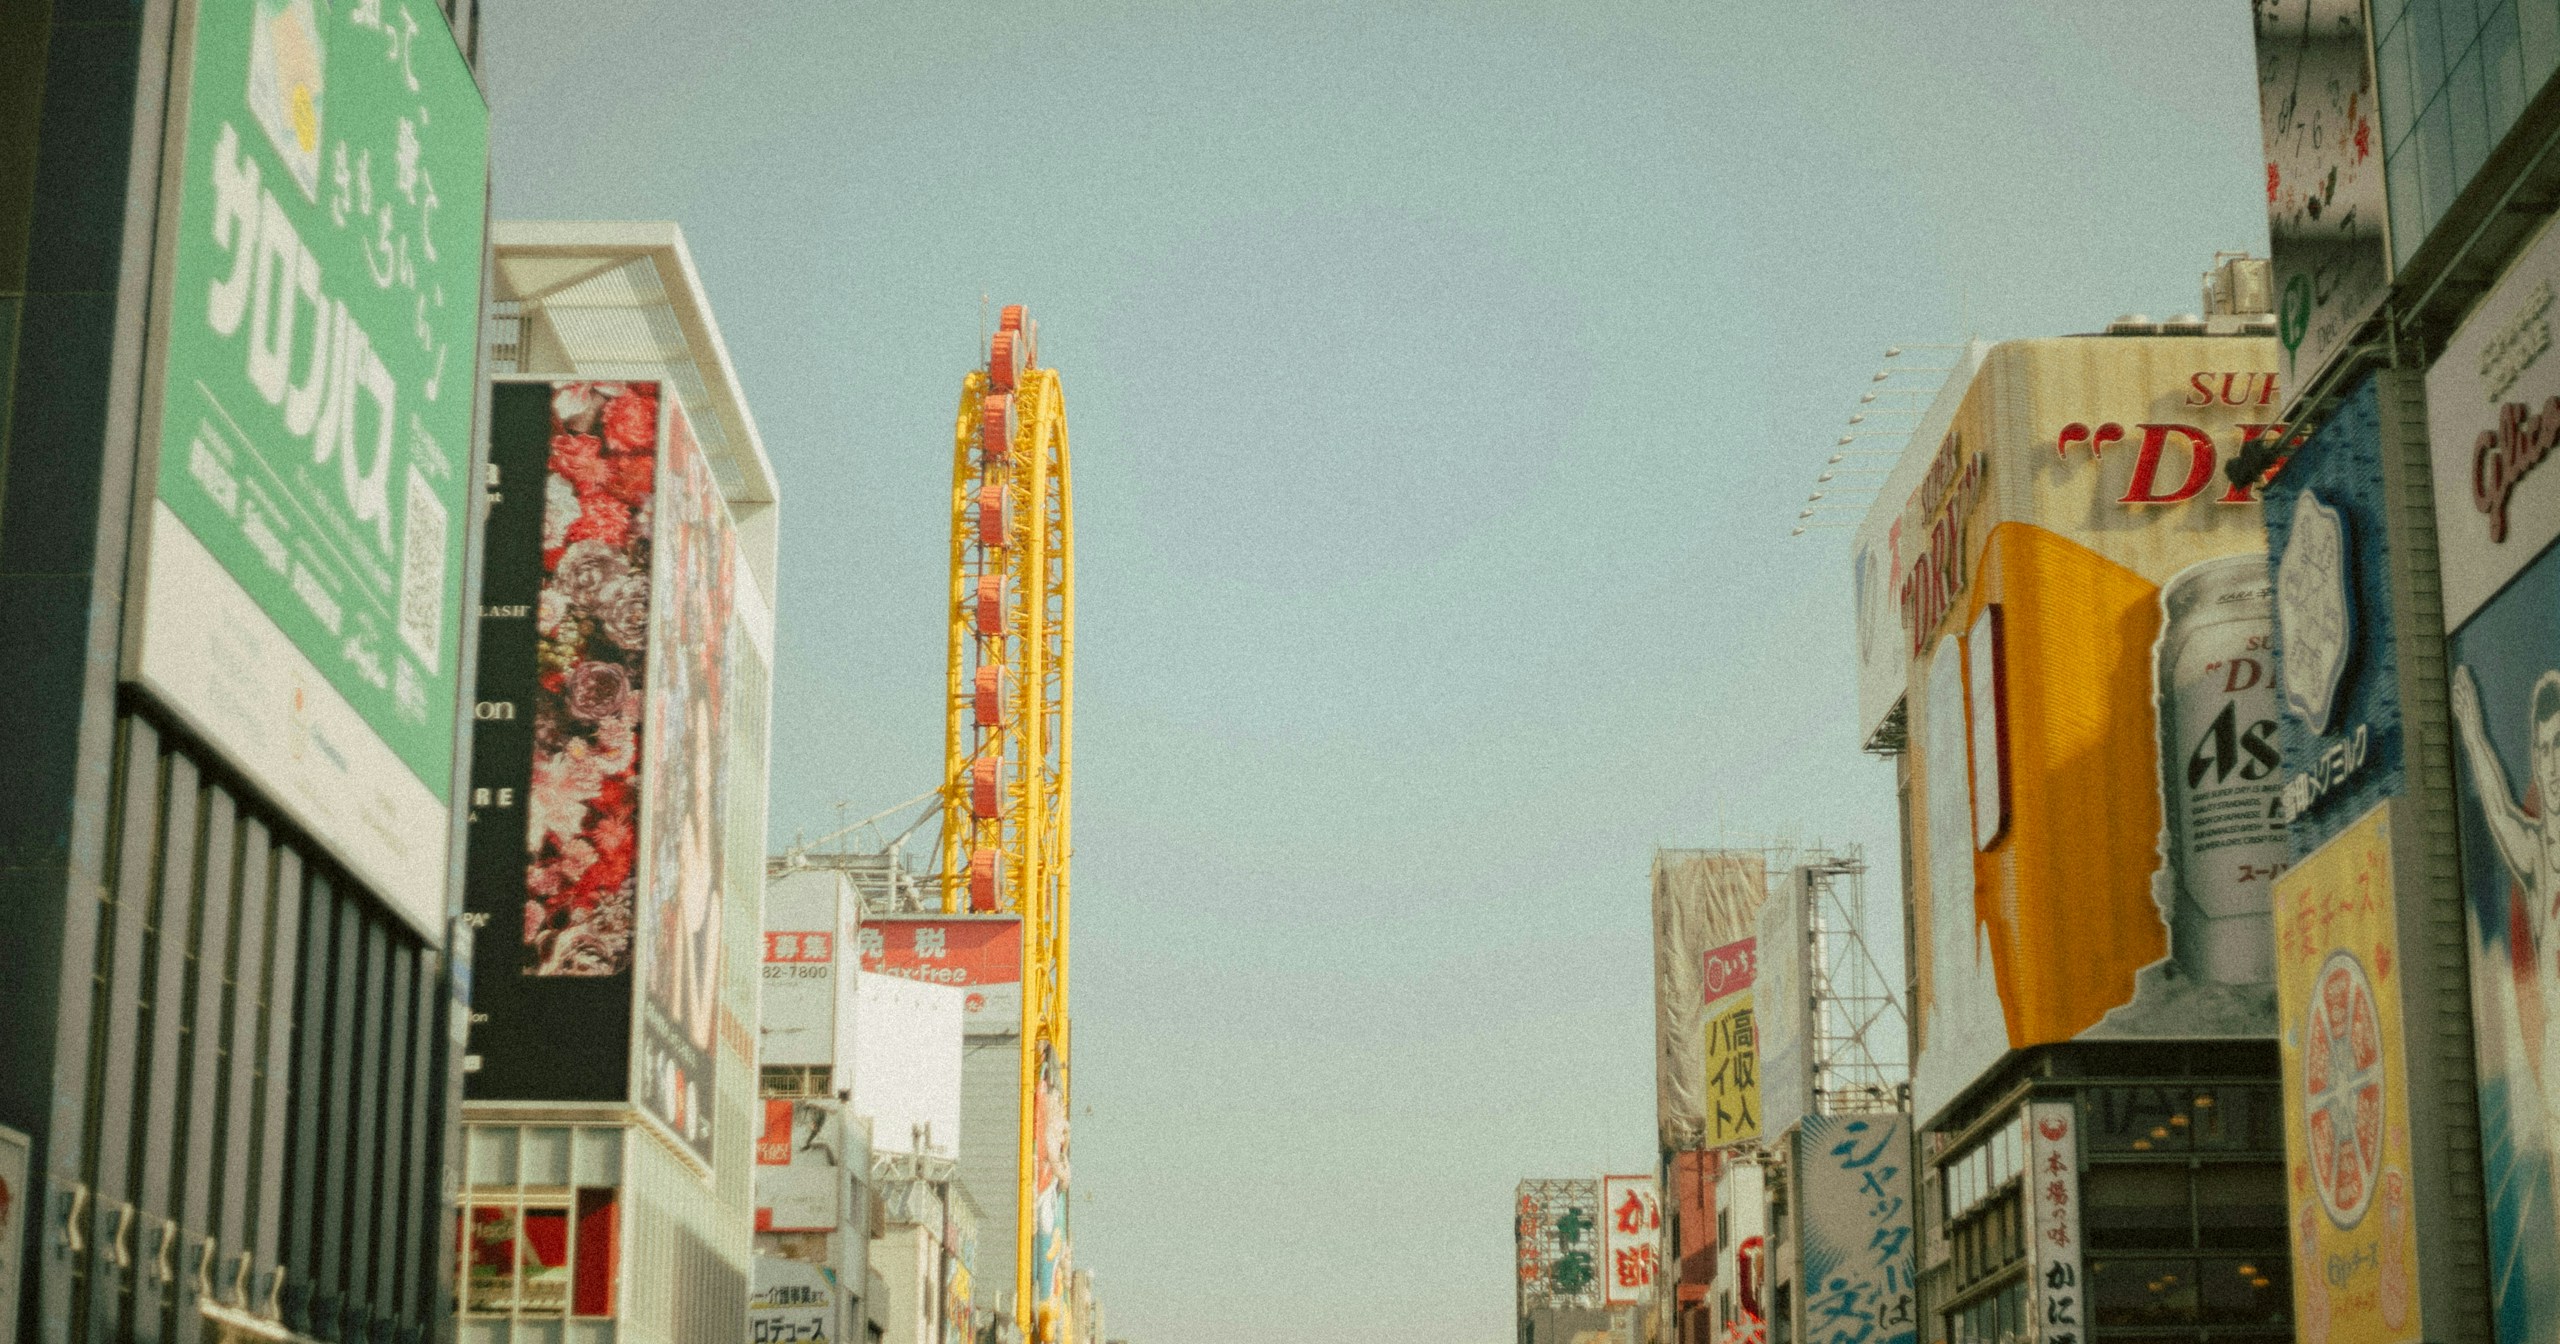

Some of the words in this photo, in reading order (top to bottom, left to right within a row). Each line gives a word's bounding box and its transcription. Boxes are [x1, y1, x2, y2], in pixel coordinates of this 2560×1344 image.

[474, 701, 514, 721] on
[1709, 1013, 1735, 1139] バイト
[1731, 1006, 1756, 1133] 高収入
[751, 1315, 825, 1344] ロデュース
[2045, 1260, 2078, 1344] かに
